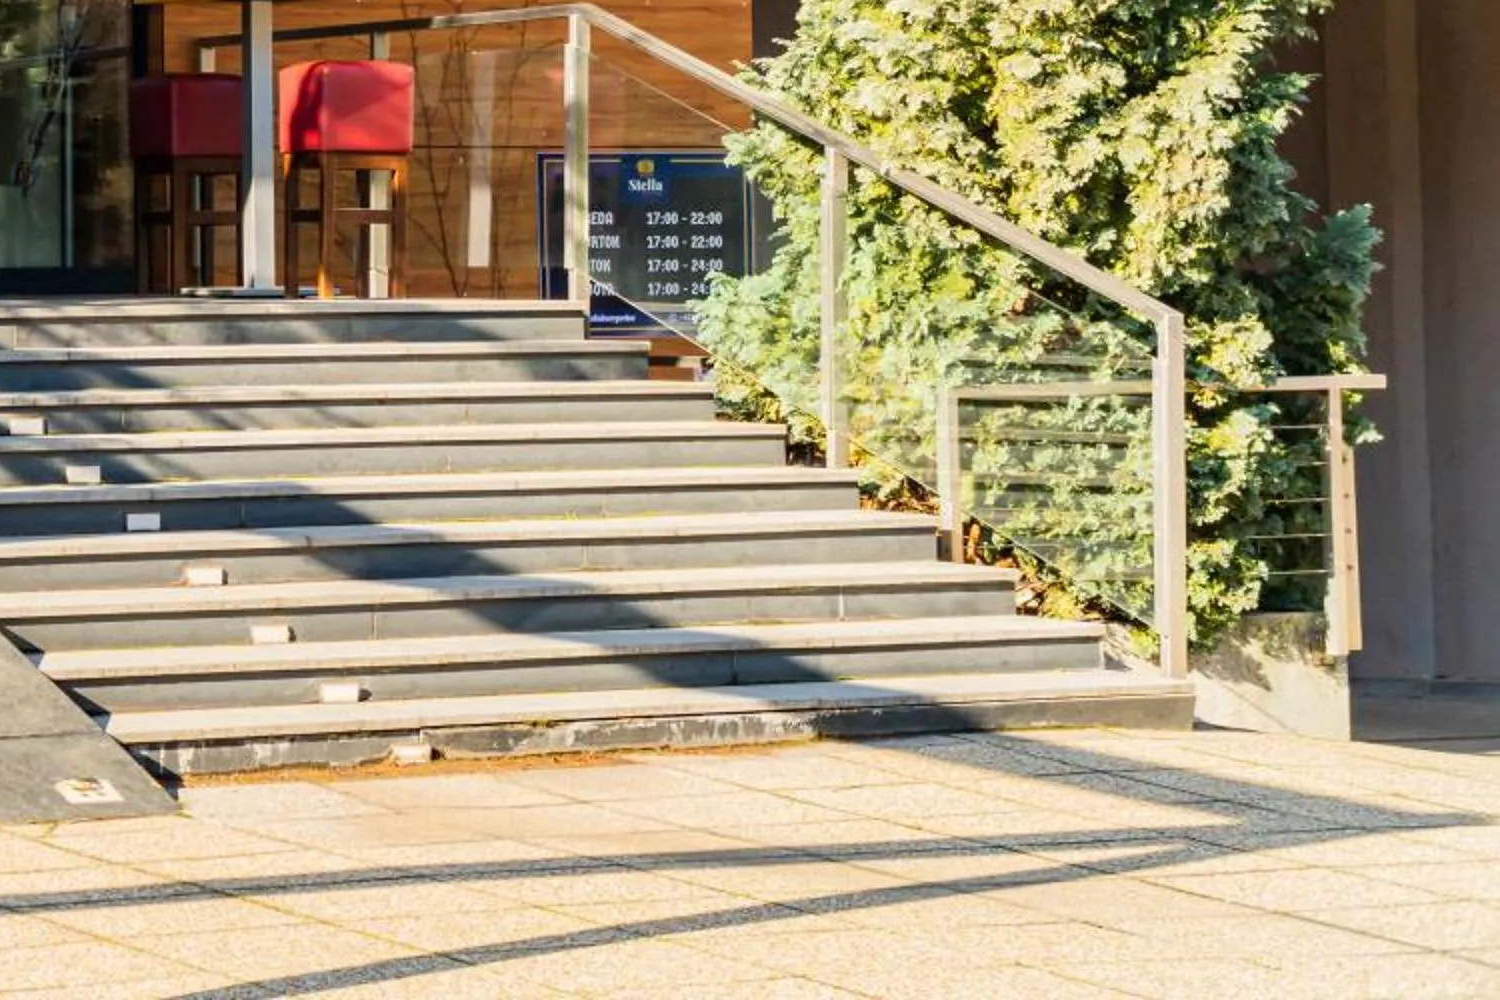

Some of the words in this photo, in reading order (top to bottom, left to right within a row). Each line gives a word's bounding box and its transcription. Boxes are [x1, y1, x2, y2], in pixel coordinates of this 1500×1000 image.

[589, 211, 614, 225] EDA
[646, 211, 679, 225] 17:00
[690, 211, 723, 225] 22:00
[646, 235, 679, 249] 17:00
[690, 235, 723, 249] 22:00
[589, 258, 612, 274] TOK
[647, 259, 679, 273] 17:00
[691, 259, 723, 273] 24:00
[647, 282, 680, 297] 17:00
